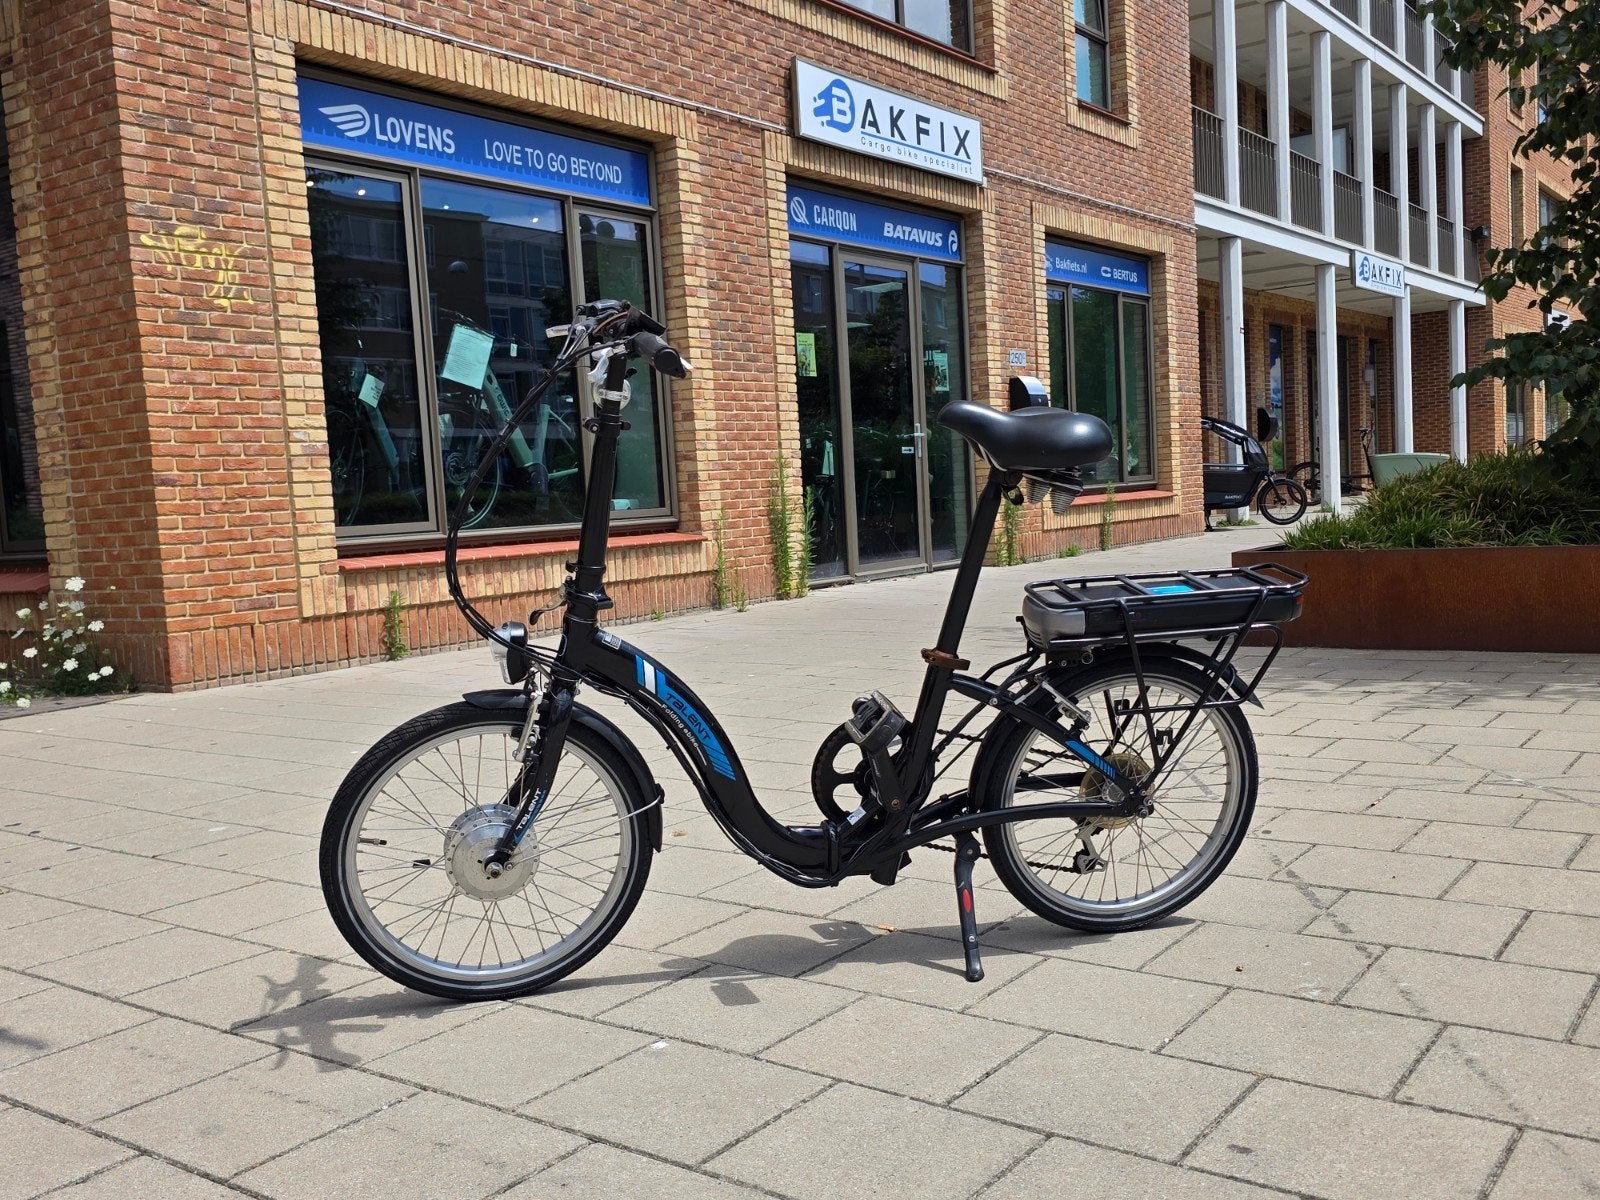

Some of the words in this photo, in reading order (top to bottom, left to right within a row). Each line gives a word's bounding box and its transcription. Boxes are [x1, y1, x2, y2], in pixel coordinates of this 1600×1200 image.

[374, 113, 456, 154] LOVENS
[829, 85, 972, 160] BAKFIX
[484, 138, 523, 166] LOVE
[524, 147, 544, 170] TO
[547, 152, 567, 174] GO
[571, 155, 622, 185] BEYOND
[860, 136, 891, 152] Cargo
[897, 147, 918, 160] bike
[923, 155, 973, 175] specialist
[813, 204, 858, 232] CARQON
[883, 222, 943, 247] BATAVUS
[1055, 257, 1088, 274] Bakfiets.nl
[1113, 268, 1138, 283] BERTUS
[1361, 258, 1402, 287] BAKFIX
[661, 703, 685, 729] Folding
[683, 728, 699, 748] ebike
